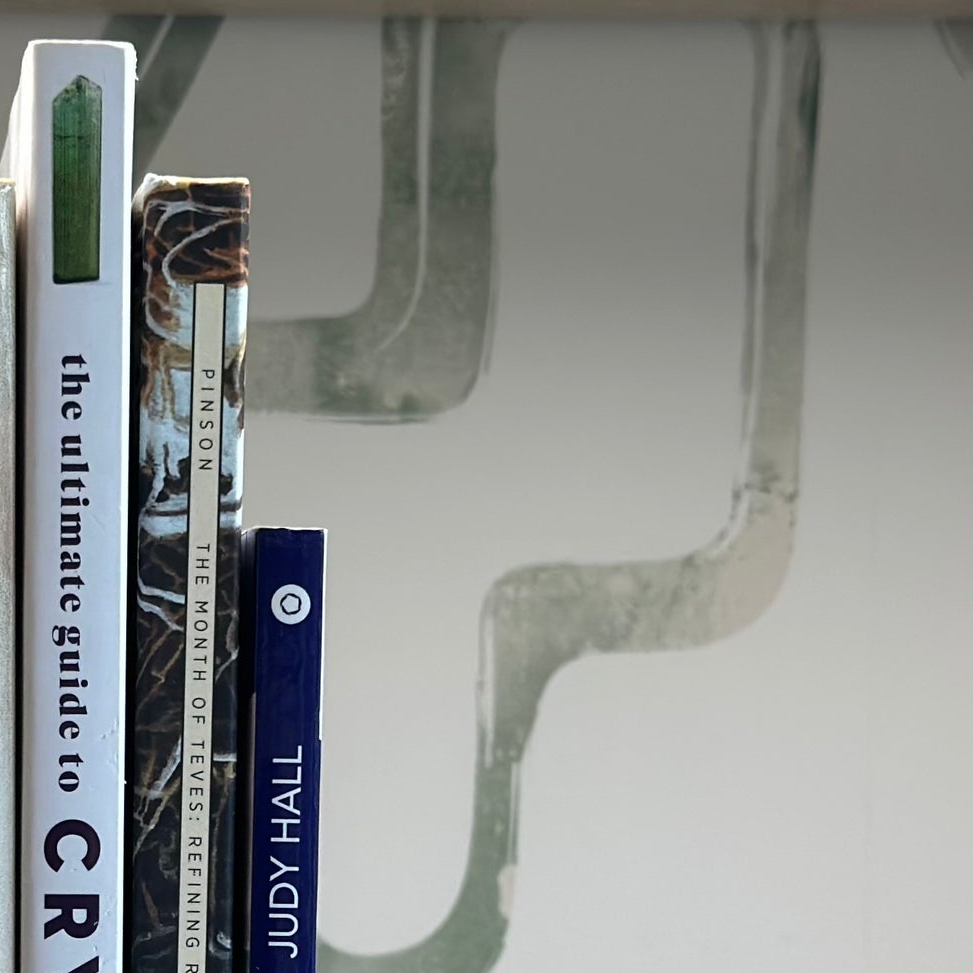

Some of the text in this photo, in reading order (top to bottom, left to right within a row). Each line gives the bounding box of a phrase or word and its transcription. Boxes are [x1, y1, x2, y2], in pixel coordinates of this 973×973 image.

[60, 353, 90, 421] the
[199, 368, 214, 471] PINSON
[59, 433, 91, 613] ultimate
[194, 543, 210, 586] THE
[192, 601, 208, 681] MONTH
[51, 624, 89, 740] guide
[191, 697, 206, 726] OF
[58, 753, 86, 793] to
[188, 741, 204, 822] TEVES:
[268, 745, 302, 958] JUDY HALL
[185, 836, 202, 949] REFINING
